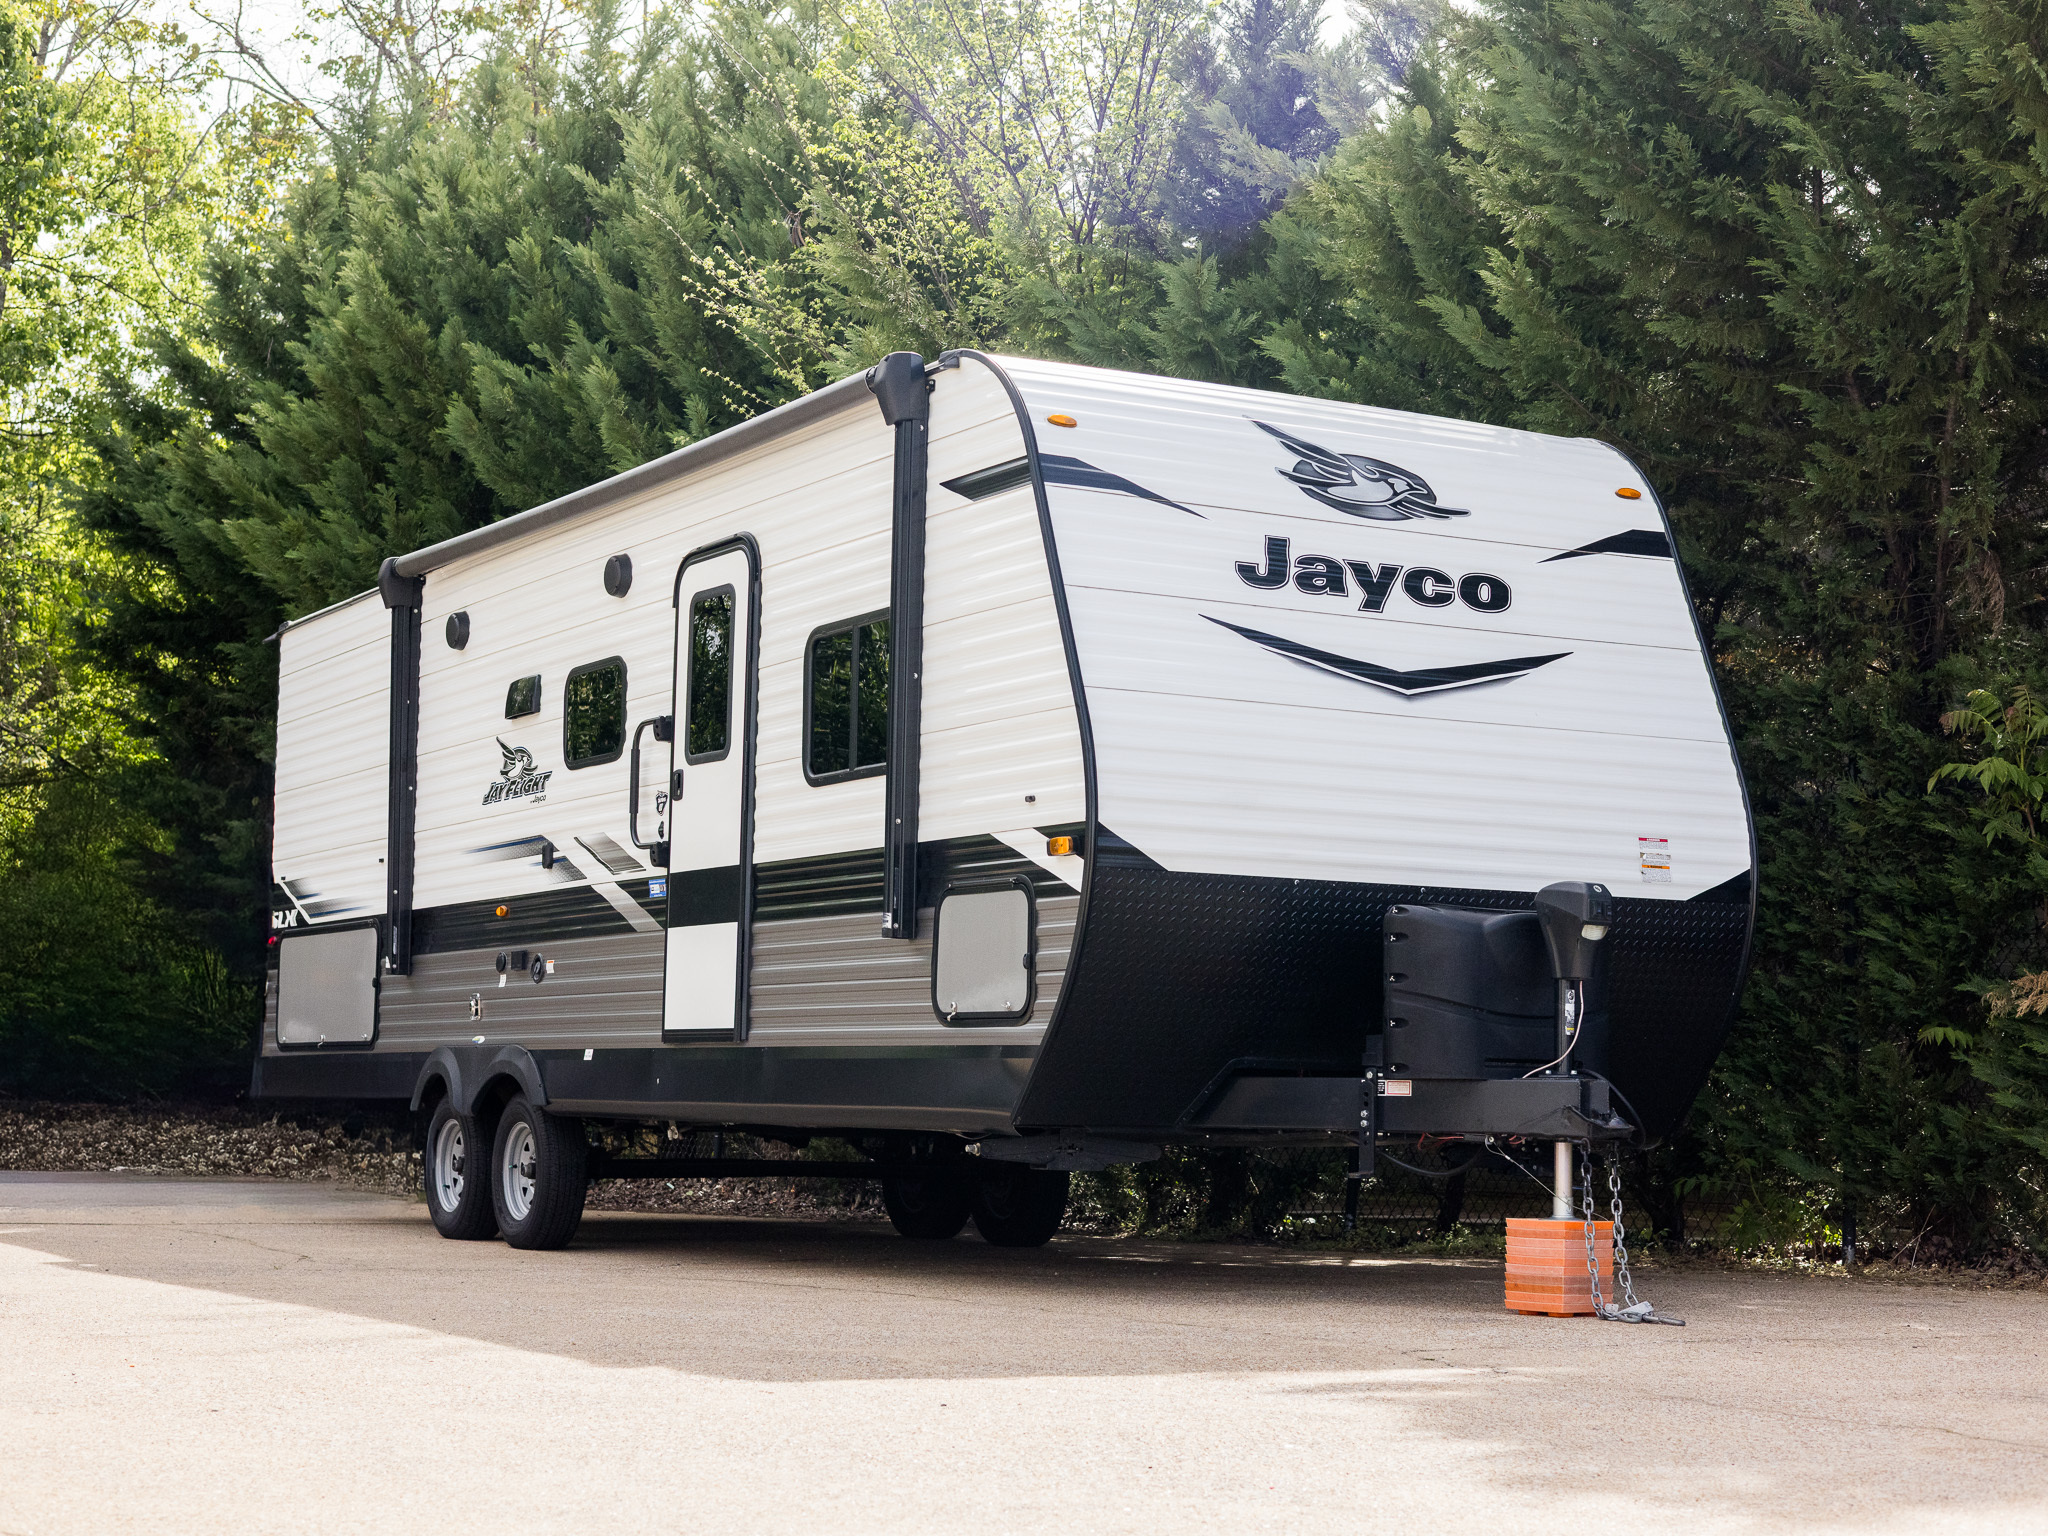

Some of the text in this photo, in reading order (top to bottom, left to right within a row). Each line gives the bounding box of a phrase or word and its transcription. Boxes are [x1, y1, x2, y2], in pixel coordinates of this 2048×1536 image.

[1235, 535, 1512, 613] Jayco
[482, 771, 552, 805] JAY FLIGHT
